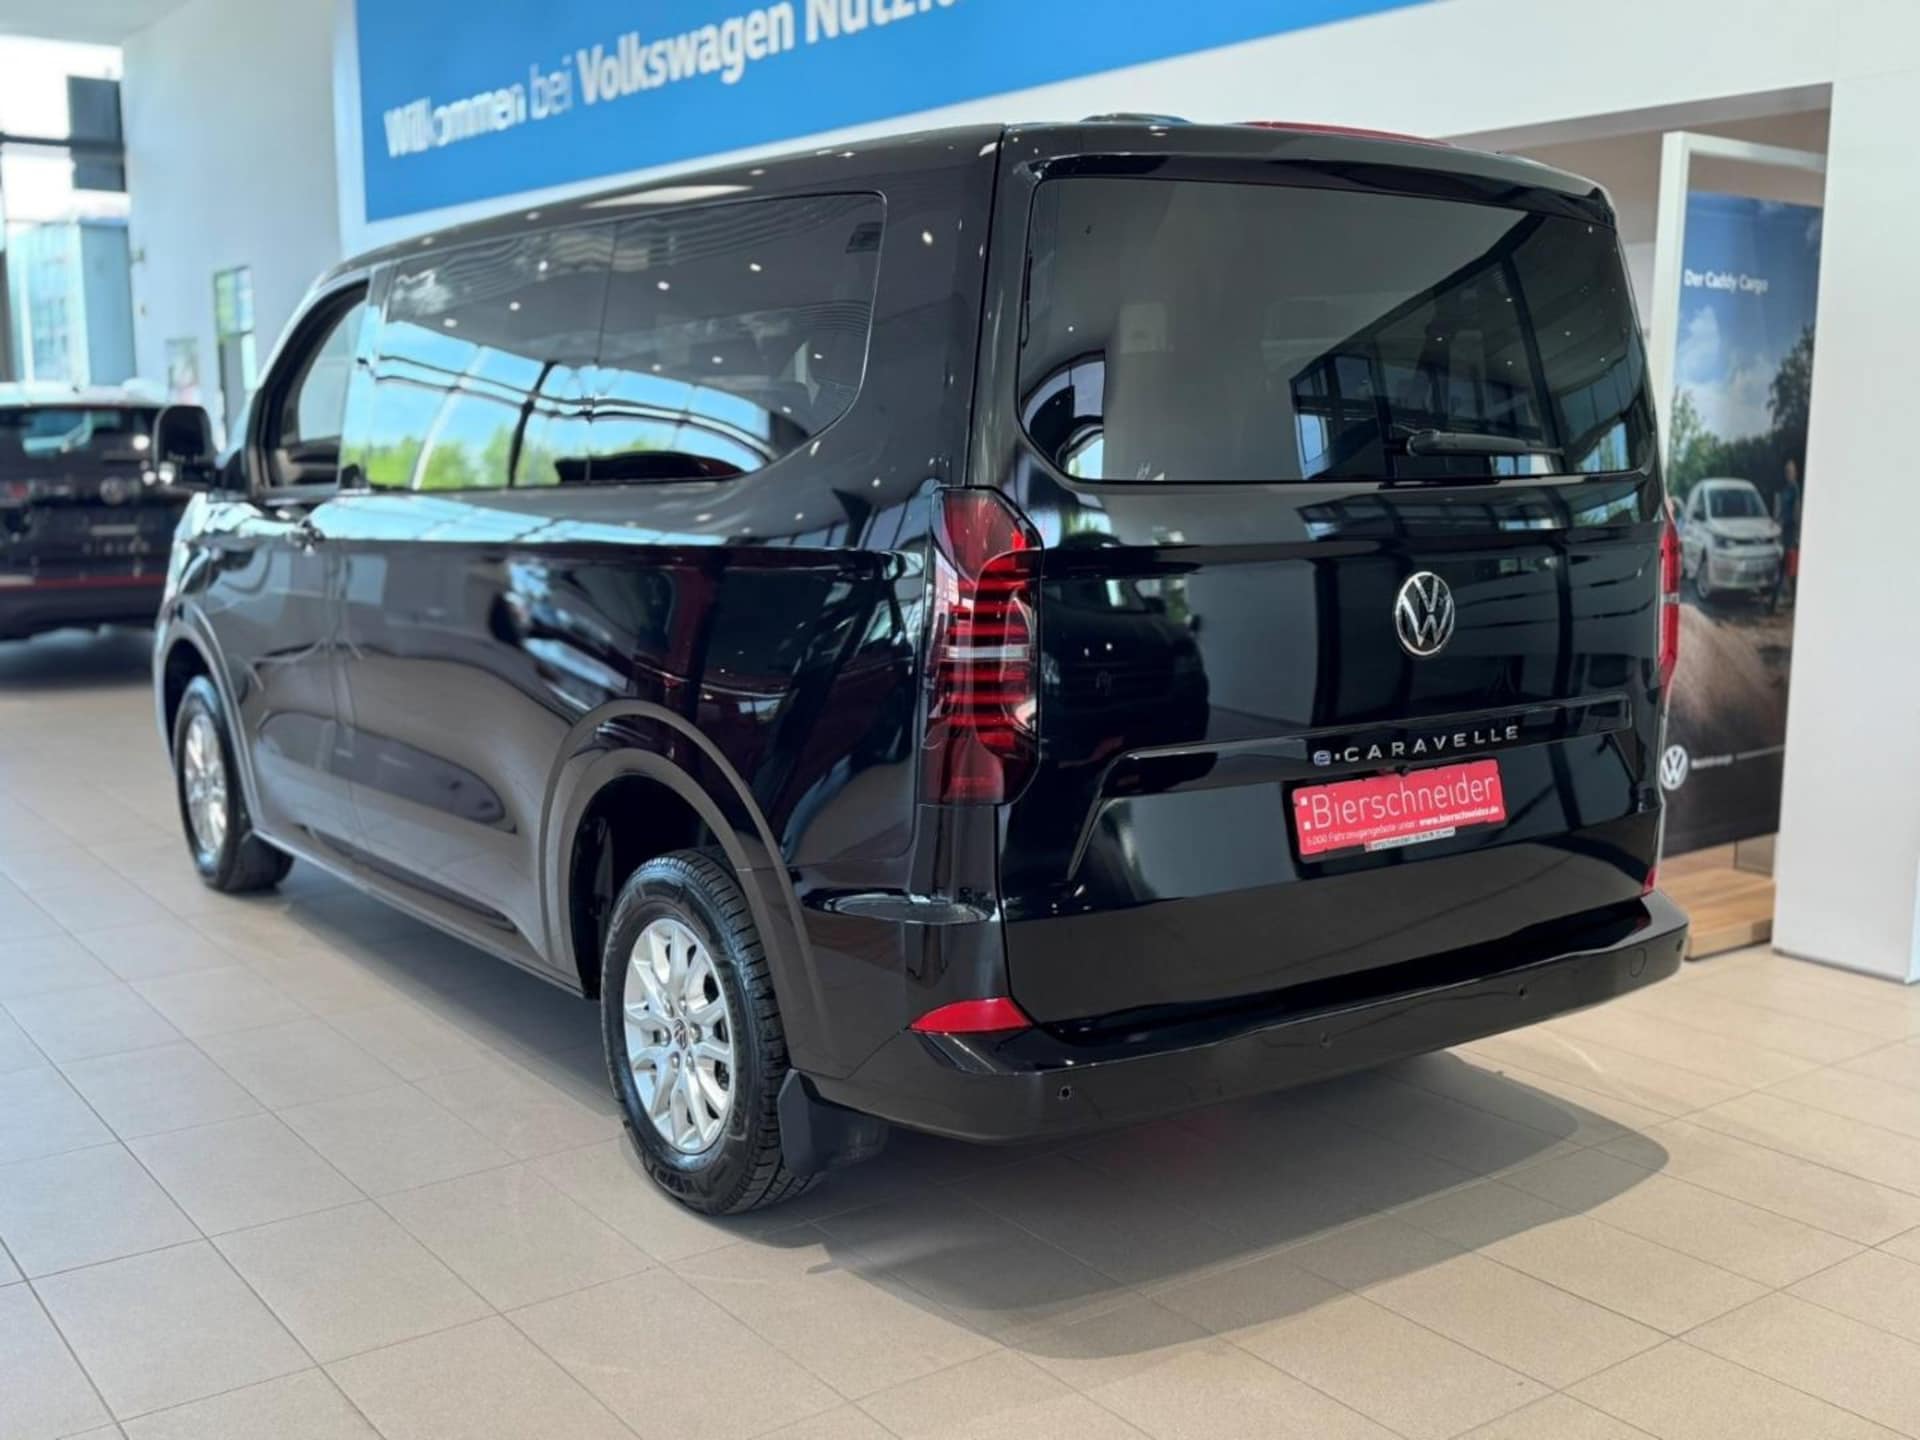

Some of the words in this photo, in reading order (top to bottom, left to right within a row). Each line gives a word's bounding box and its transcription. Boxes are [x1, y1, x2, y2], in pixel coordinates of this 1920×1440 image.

[384, 82, 527, 158] Willkommen
[529, 54, 572, 120] bei
[576, 1, 795, 105] Volkswagen
[805, 0, 958, 44] Nut
[1684, 268, 1704, 288] Der
[1705, 270, 1736, 293] Caddy
[1739, 273, 1768, 295] Cargo
[1311, 775, 1495, 829] Bierschneider
